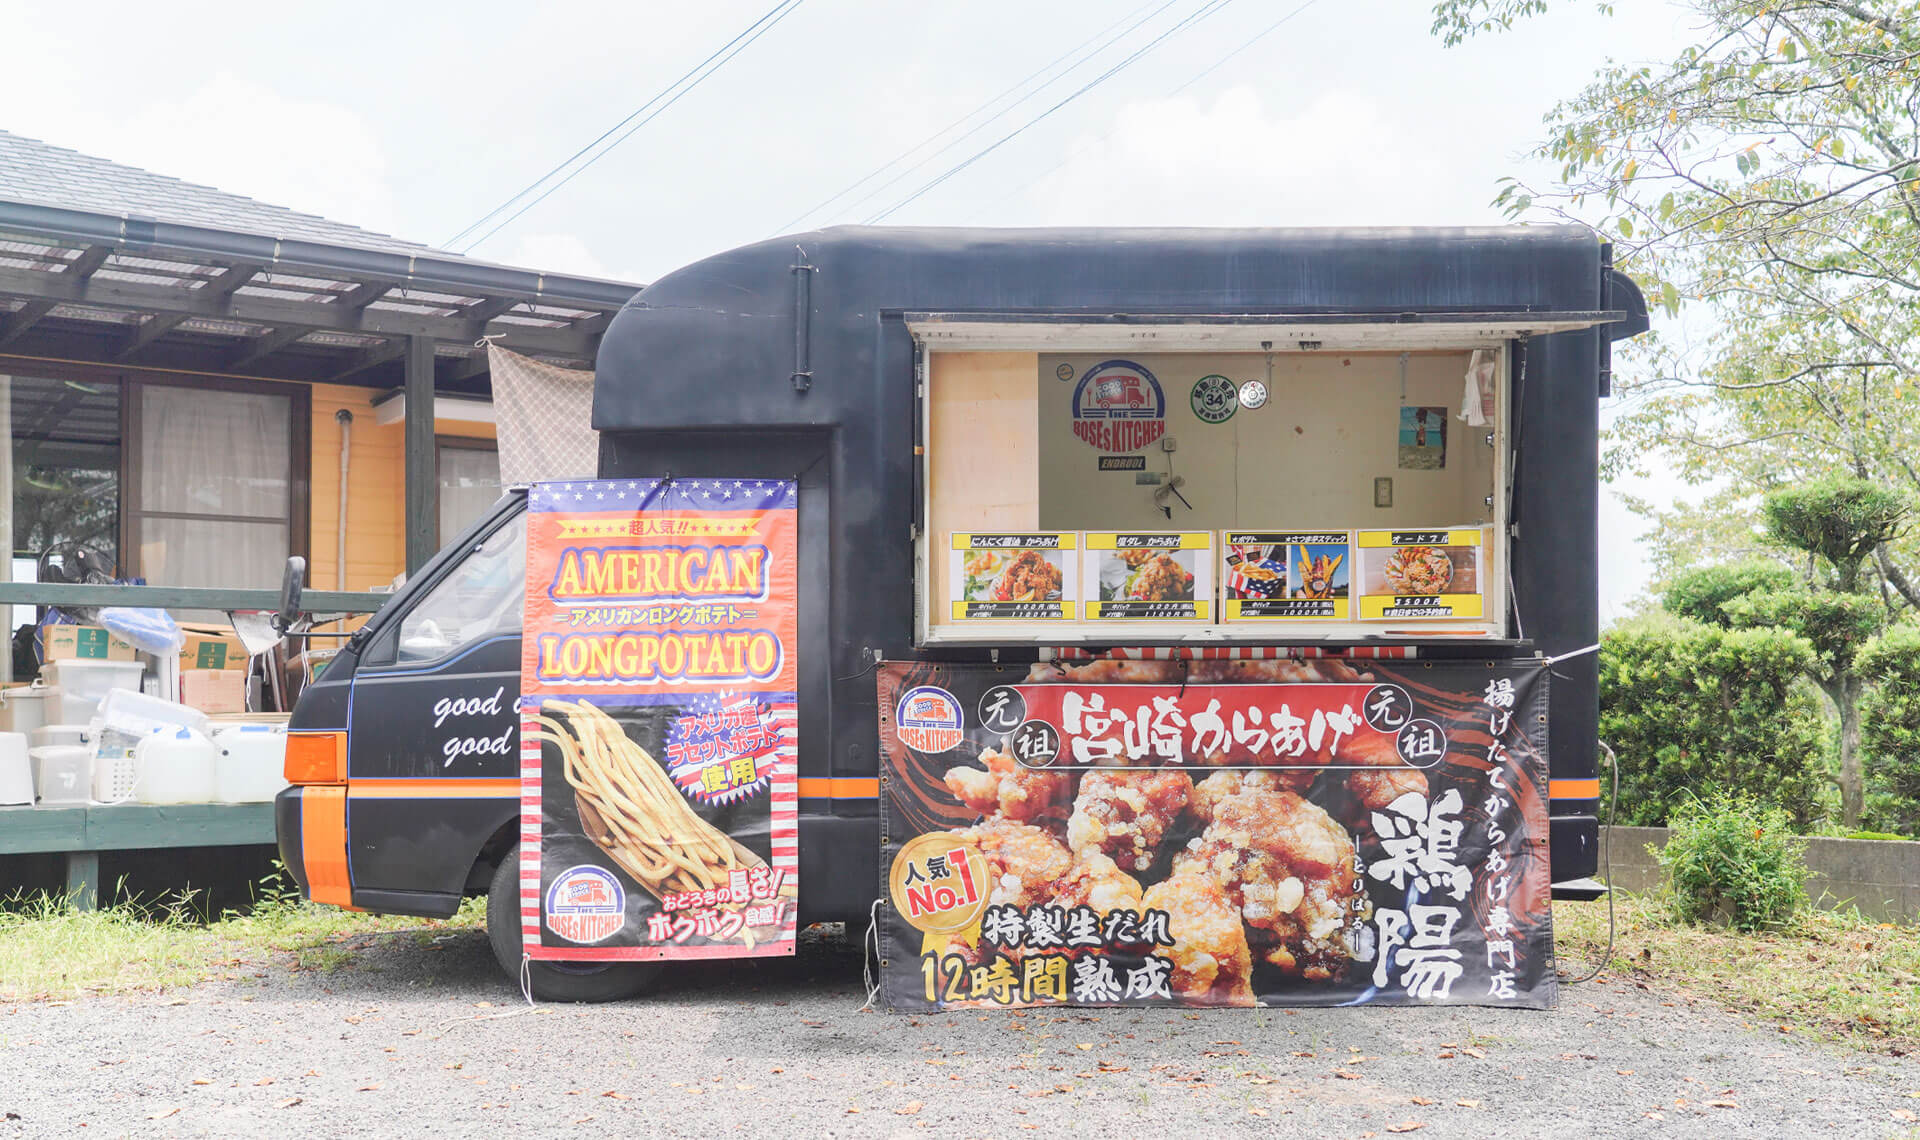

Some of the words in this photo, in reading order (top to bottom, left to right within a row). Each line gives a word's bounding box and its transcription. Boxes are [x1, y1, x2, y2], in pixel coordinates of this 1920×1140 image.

[1206, 393, 1224, 406] 34
[1112, 420, 1165, 453] KITCHEN
[628, 519, 689, 536] 超人気!!
[556, 550, 763, 596] AMERICAN
[570, 606, 742, 626] アメリカンロングポテト
[541, 635, 775, 676] LONGPOTATO
[433, 686, 504, 728] good
[679, 704, 759, 738] アメリカ産
[443, 725, 513, 767] good
[667, 724, 778, 766] ラセットポテト
[702, 757, 757, 793] 使用
[1483, 679, 1518, 1000] 揚げたてからあげ専門店
[663, 868, 785, 911] おどろきの長さ!
[904, 856, 950, 887] 人気
[984, 907, 1175, 946] 特製生だれ
